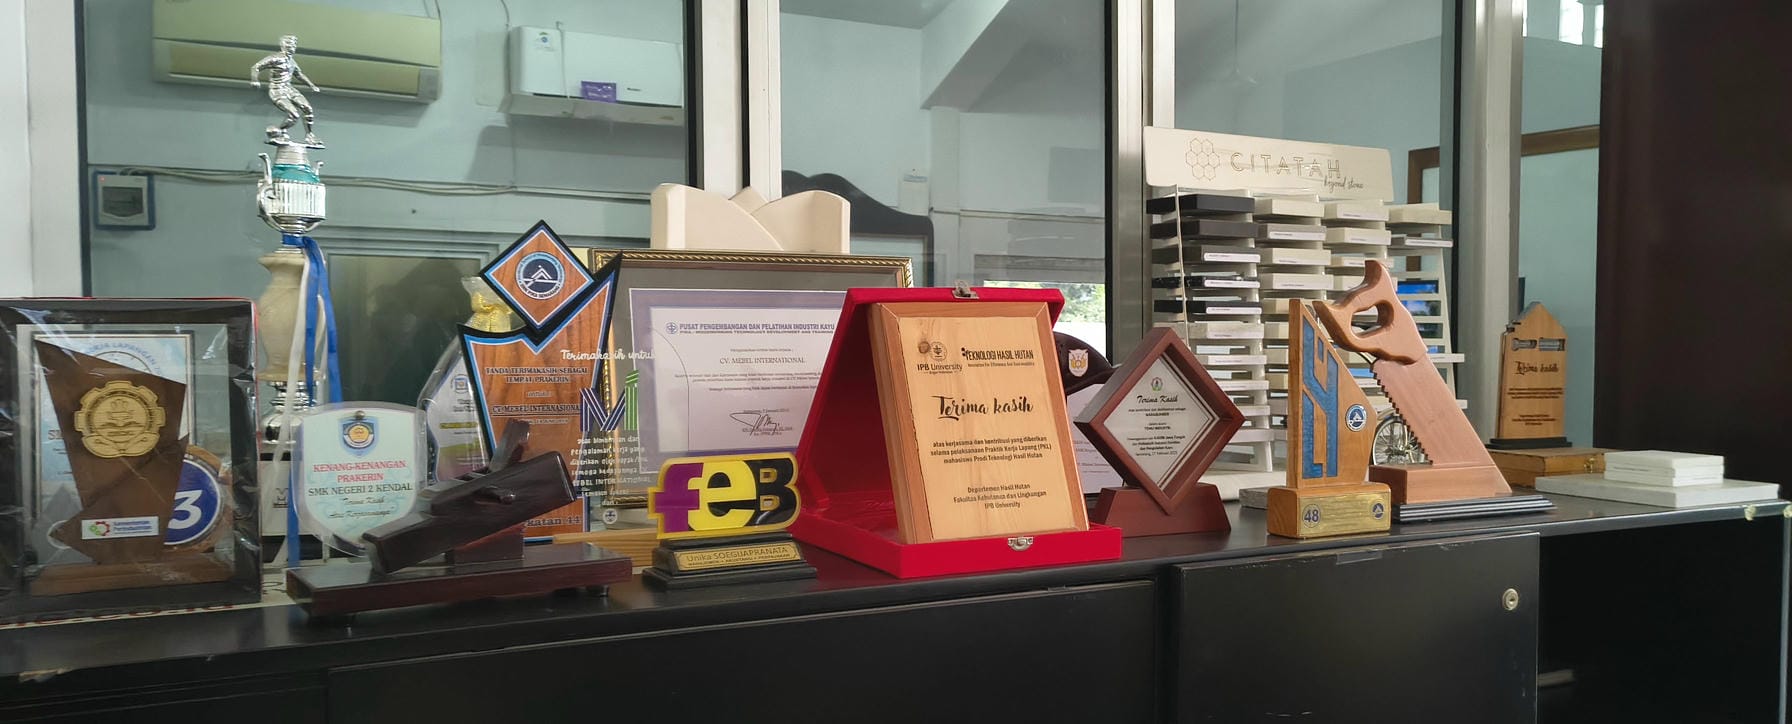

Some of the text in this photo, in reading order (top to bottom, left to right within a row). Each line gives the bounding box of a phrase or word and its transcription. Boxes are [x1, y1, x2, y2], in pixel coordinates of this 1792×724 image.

[1230, 152, 1341, 179] CITATAH
[754, 356, 805, 364] INTERNATIONAL
[965, 349, 1034, 360] TEKNOLOGI HASIL HUTAN
[917, 363, 963, 371] IPB University
[1136, 394, 1178, 404] Terima Kasih
[931, 395, 1034, 421] Terima kasih
[950, 448, 984, 456] pelaksanaan
[1004, 445, 1018, 453] Kerja
[1037, 443, 1052, 451] (PKL)
[988, 454, 1013, 462] Teknologi
[313, 460, 407, 472] KENANG-KENANGAN
[337, 473, 384, 483] PRAKERIN
[308, 482, 413, 496] SMK NEGERI 2 KENDAL
[967, 486, 1000, 494] Departemen
[977, 494, 1006, 502] Kehutanan
[1017, 490, 1047, 499] Lingkungan
[168, 489, 203, 530] 3
[995, 501, 1021, 509] University
[1303, 509, 1320, 523] 48
[686, 553, 712, 562] Unika
